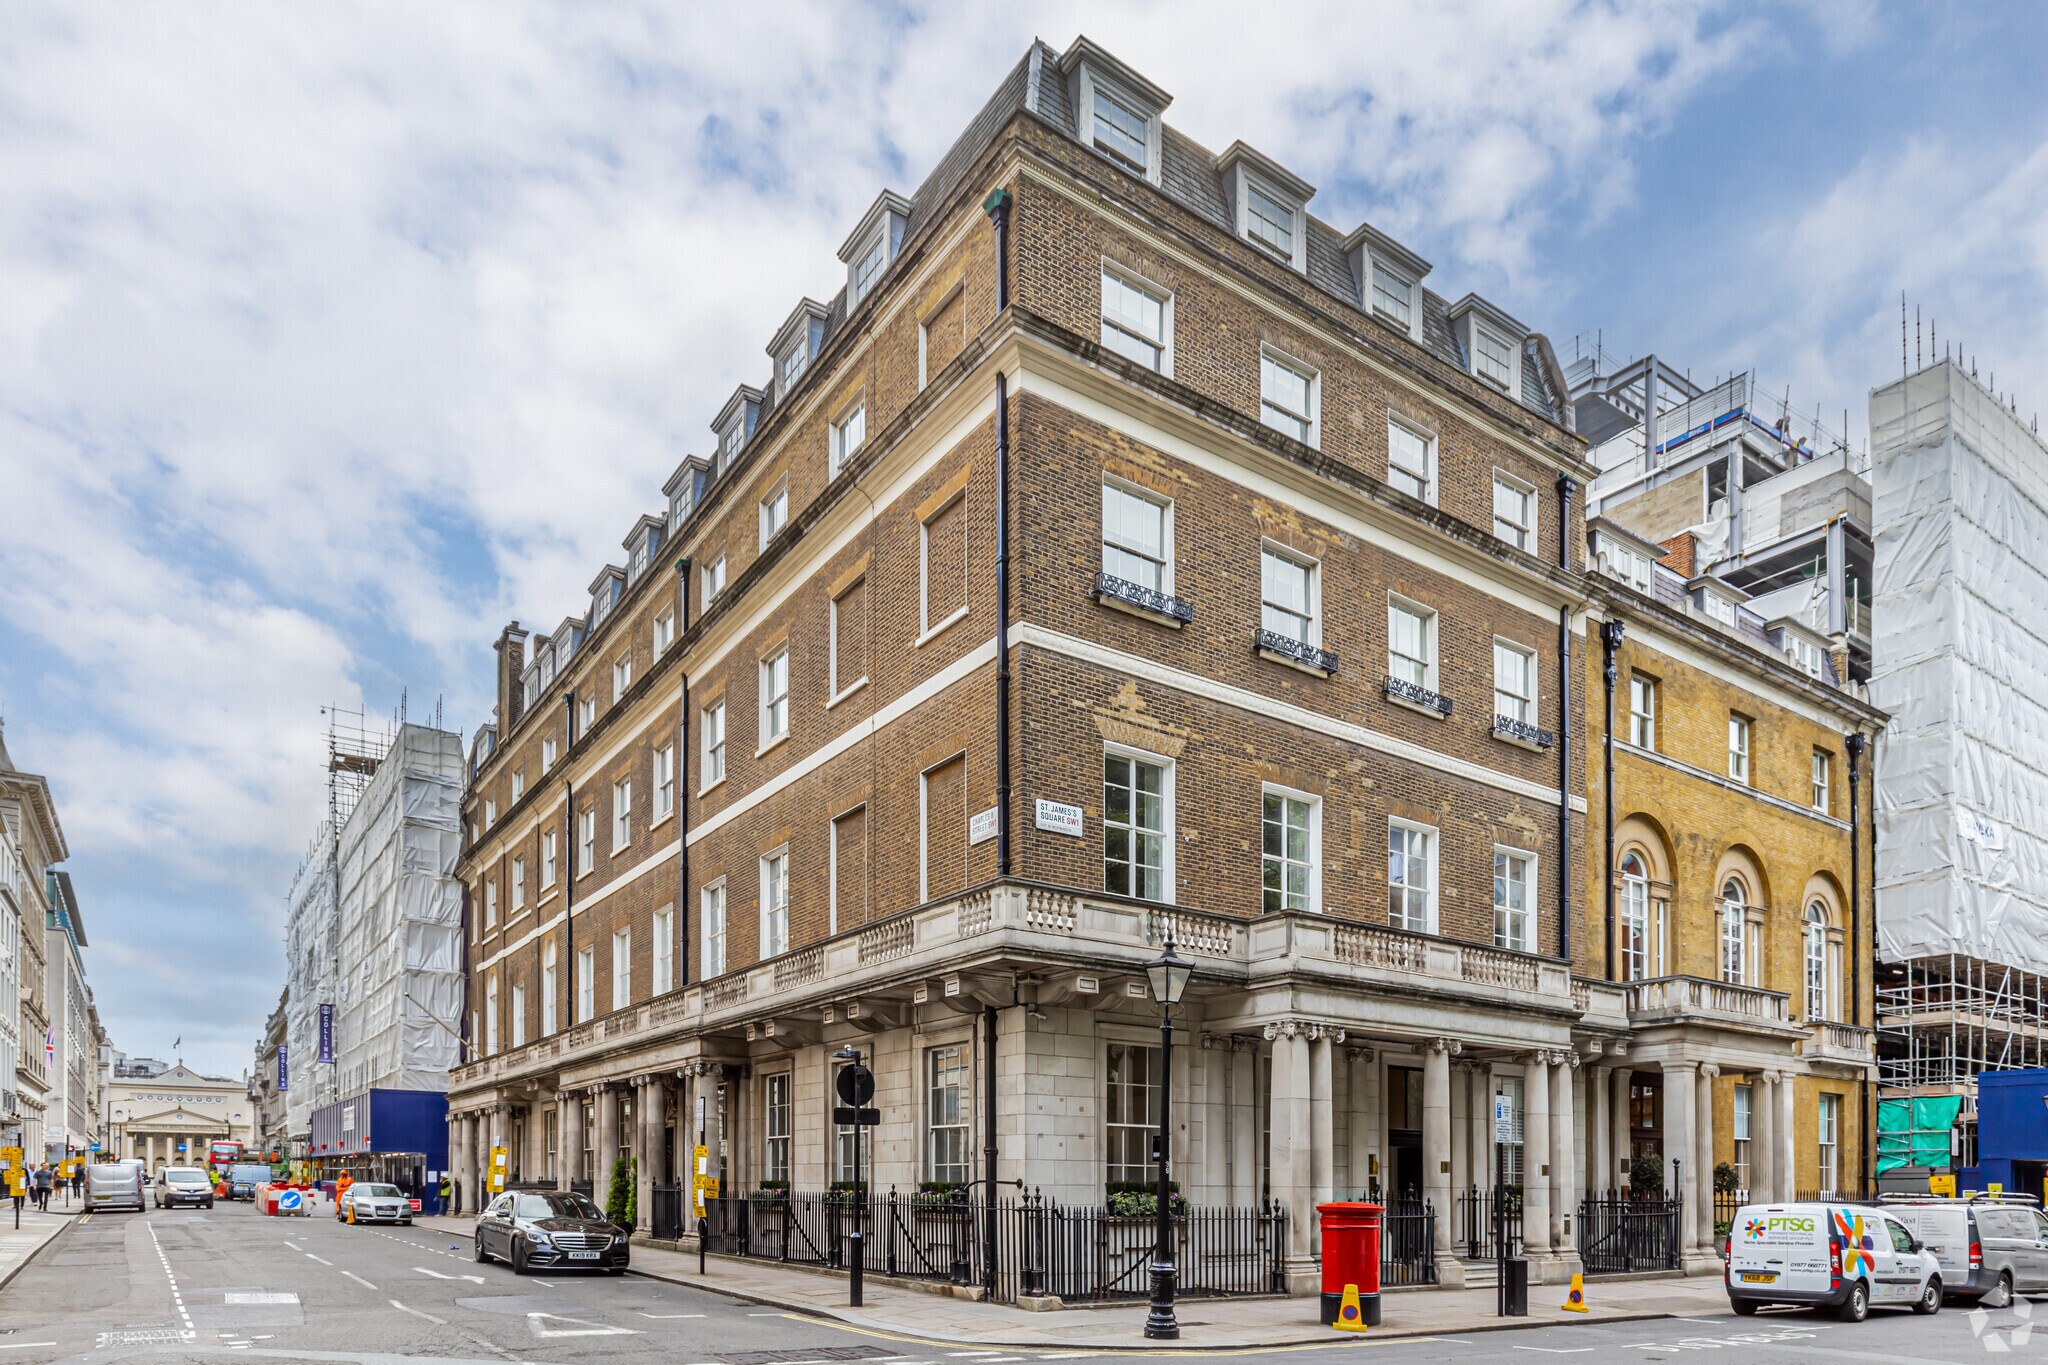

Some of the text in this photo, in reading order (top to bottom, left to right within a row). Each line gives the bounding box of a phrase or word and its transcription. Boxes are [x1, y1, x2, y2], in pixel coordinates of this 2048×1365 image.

[1040, 802, 1077, 818] ST. JAMES'S
[972, 812, 990, 827] CHARLES
[972, 818, 997, 836] STREET SW1
[1040, 811, 1079, 827] SQUARE SW1
[1768, 1217, 1814, 1232] PTSG
